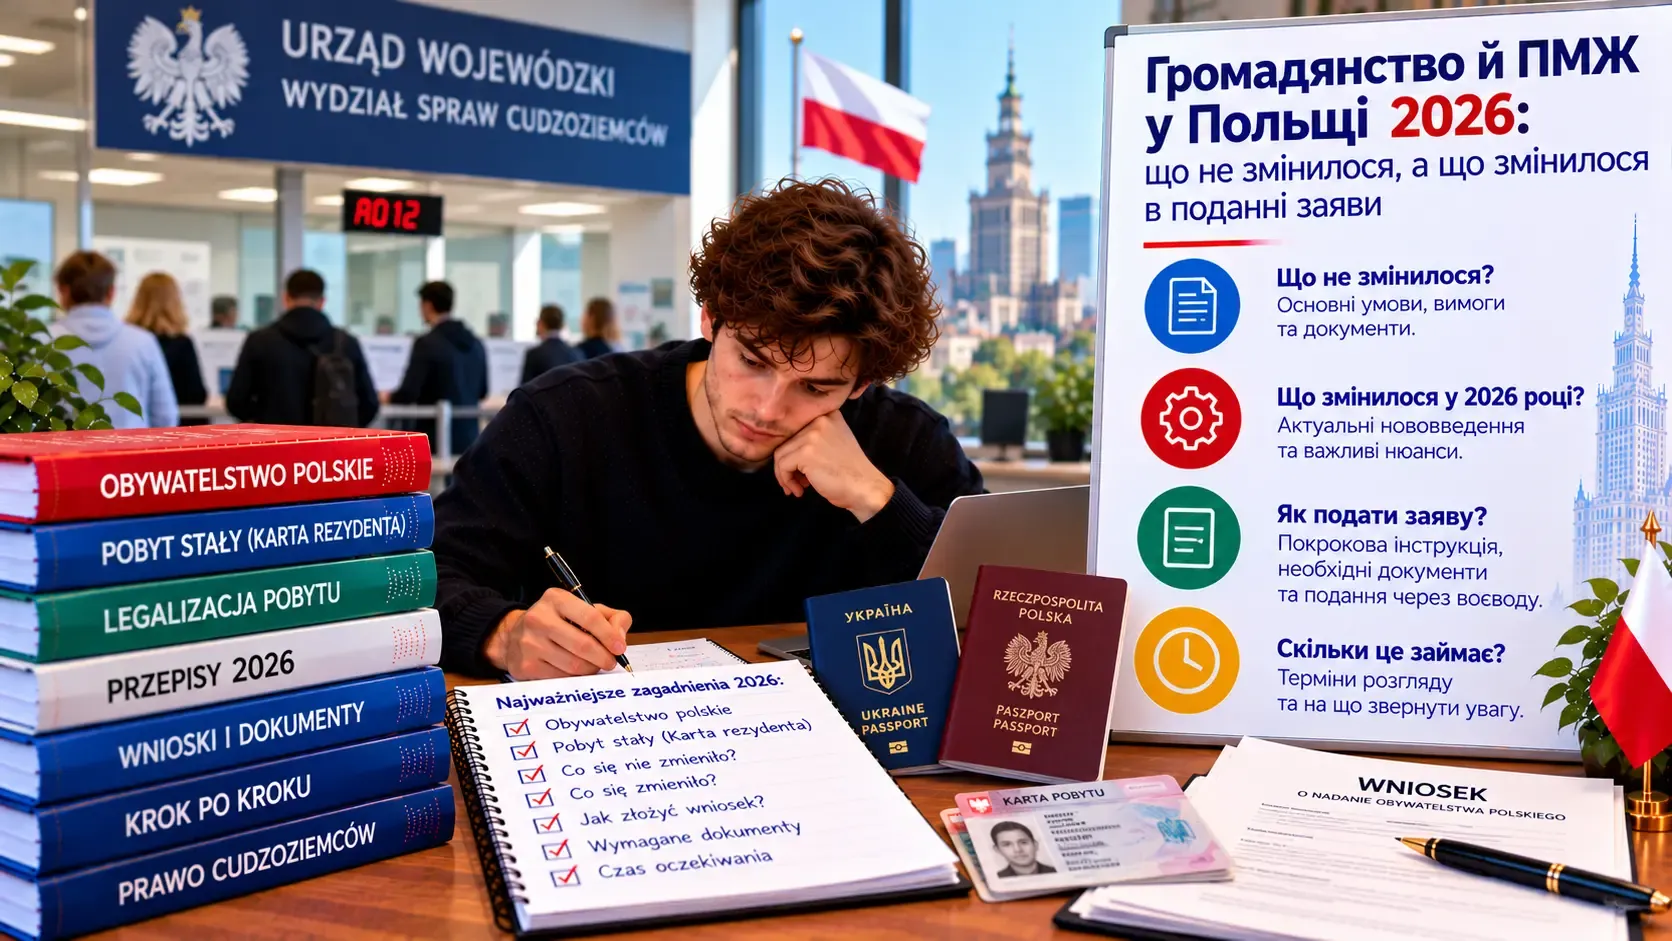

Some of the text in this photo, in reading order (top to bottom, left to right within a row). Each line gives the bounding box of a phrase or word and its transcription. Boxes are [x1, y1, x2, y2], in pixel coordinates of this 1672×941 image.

[283, 20, 614, 97] URZĄD WOJEWÓDZKI
[1147, 35, 1640, 101] Громадянство й ПМЖ
[282, 79, 668, 146] WYDZIAŁ SPRAW CUDZOZIEMCÓW
[1145, 92, 1529, 154] у Польщі 2026:
[1146, 146, 1648, 189] що не змінилося, а що змінилося
[354, 197, 420, 229] A012
[1146, 192, 1381, 225] в поданні заяви
[1278, 265, 1494, 290] Що не змінилося?
[1278, 296, 1504, 316] Основні умови, вимоги
[1277, 324, 1415, 340] та документи.
[1278, 385, 1584, 411] Що змінилося у 2026 році?
[1278, 416, 1524, 437] Актуальні нововведення
[1278, 442, 1462, 459] та важливі нюанси.
[100, 458, 374, 498] OBYWATELSTWO POLSKIE
[1277, 504, 1487, 531] Як подати заяву?
[102, 513, 405, 565] POBYT STAŁY (KARTA REZYDENTA)
[1279, 534, 1502, 558] Покрокова інструкція,
[1279, 560, 1487, 583] необхідні документи
[104, 581, 340, 633] LEGALIZACJA POBYTU
[845, 603, 912, 623] УКРАЇНА
[994, 590, 1103, 613] RZECZPOSPOLITA
[1278, 590, 1542, 611] та подання через воєводу.
[1019, 608, 1072, 624] POLSKA
[1277, 638, 1505, 664] Скільки це займає?
[108, 650, 294, 704] PRZEPISY 2026
[1278, 669, 1453, 694] Терміни розгляду
[496, 674, 784, 710] Najważniejsze zagadnienia 2026:
[545, 705, 732, 732] Obywatelstwo polskie
[862, 703, 925, 721] UKRAINE
[996, 705, 1060, 724] PASZPORT
[1277, 698, 1523, 722] та на що звернути увагу.
[118, 701, 364, 768] WNIOSKI I DOKUMENTY
[553, 718, 811, 753] Pobyt stały (Karta rezydenta)
[862, 717, 928, 735] PASSPORT
[994, 719, 1057, 737] PASSPORT
[562, 749, 736, 776] Co się nie zmieniło?
[570, 774, 716, 800] Co się zmieniło?
[1003, 789, 1104, 806] KARTA POBYTU
[1358, 777, 1487, 802] WNIOSEK
[126, 774, 310, 837] KROK PO KROKU
[580, 795, 764, 825] Jak złożyć wniosek?
[1312, 792, 1372, 804] NADANIE
[1376, 798, 1484, 815] OBYWATELSTWA
[1490, 809, 1566, 820] POLSKIEGO
[587, 821, 800, 854] Wymagane dokumenty
[119, 822, 376, 905] PRAWO CUDZOZIEMCÓW
[599, 849, 773, 878] Czas oczekiwania
